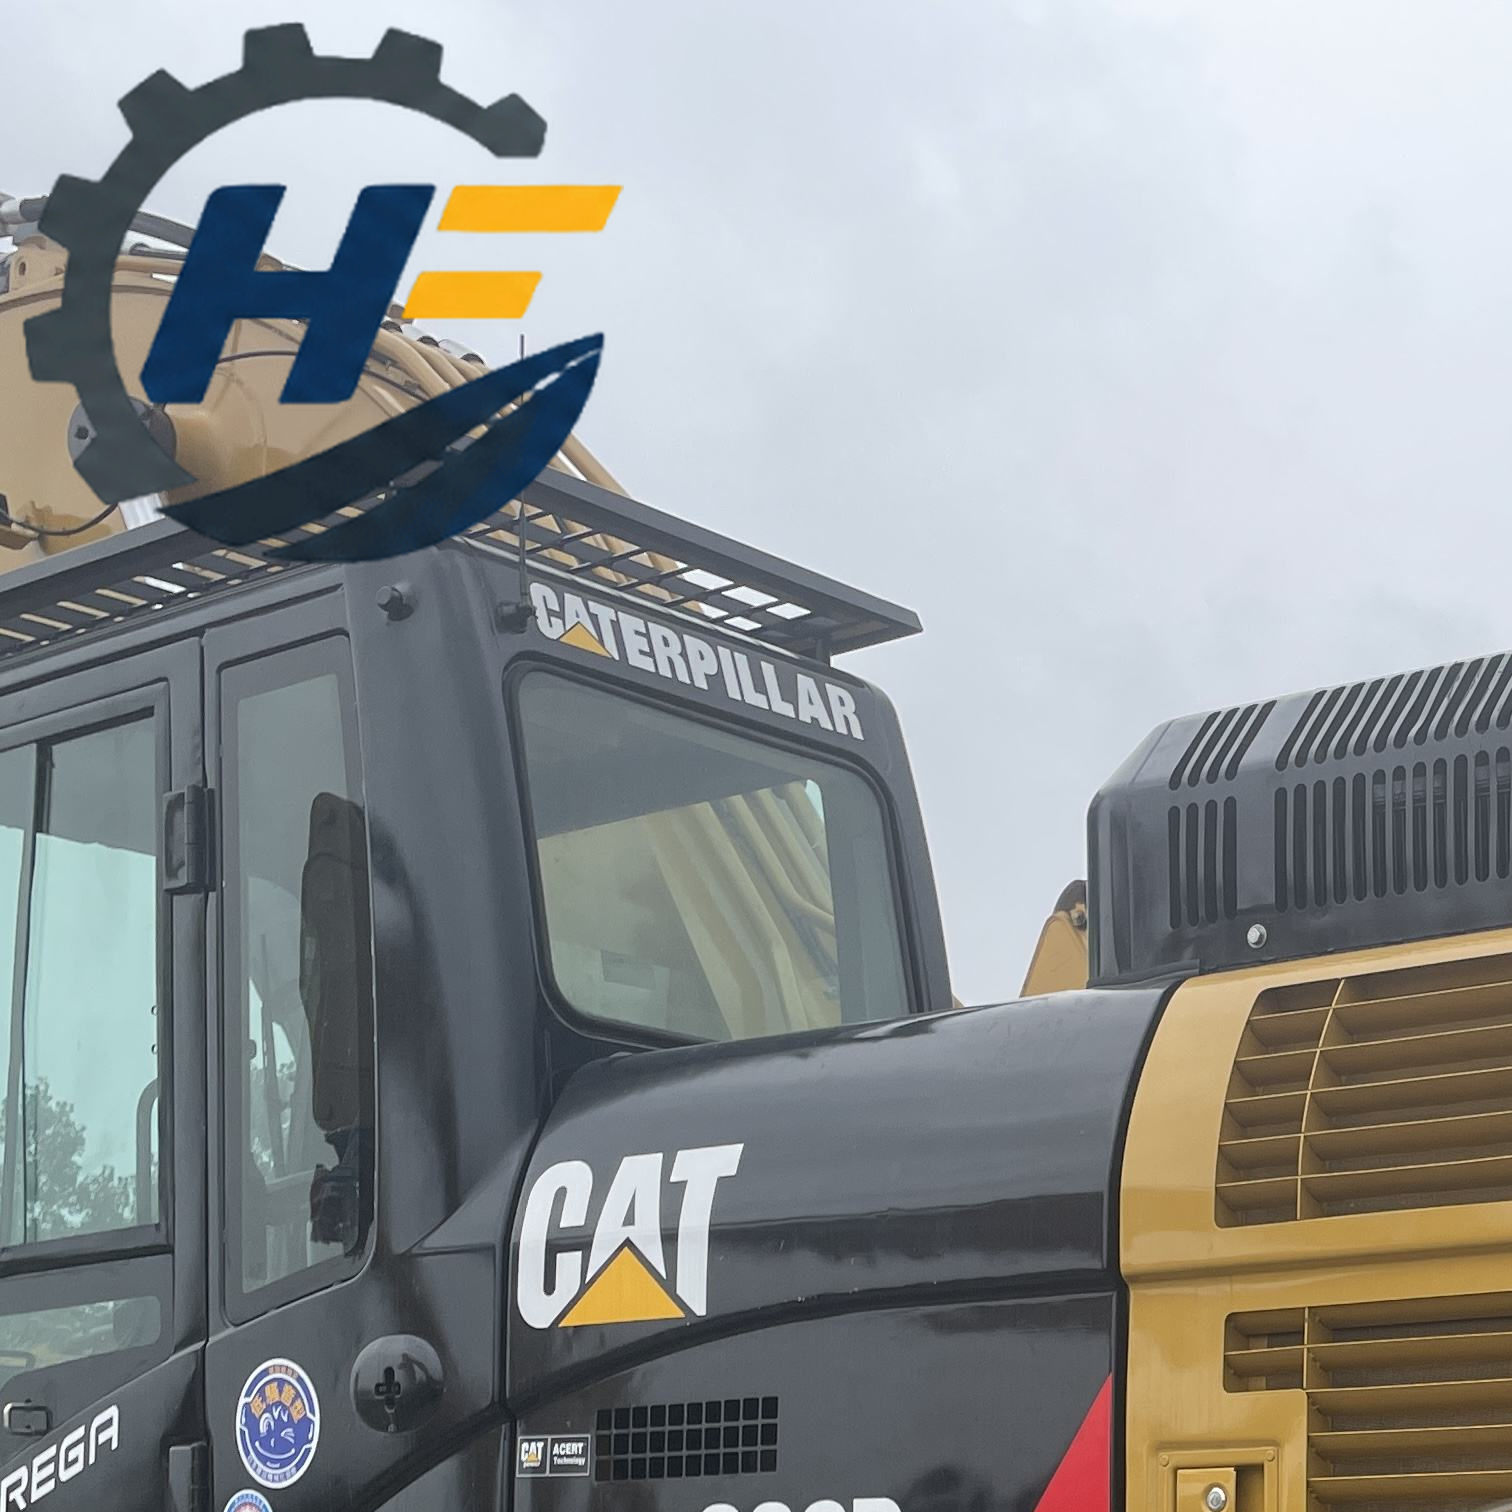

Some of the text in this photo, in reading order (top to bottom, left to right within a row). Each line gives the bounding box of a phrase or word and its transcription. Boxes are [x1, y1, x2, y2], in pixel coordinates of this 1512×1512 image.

[529, 582, 865, 741] CATERPILLAR
[517, 1143, 745, 1329] CAT
[521, 1441, 544, 1463] CAT
[552, 1441, 584, 1455] ACERT
